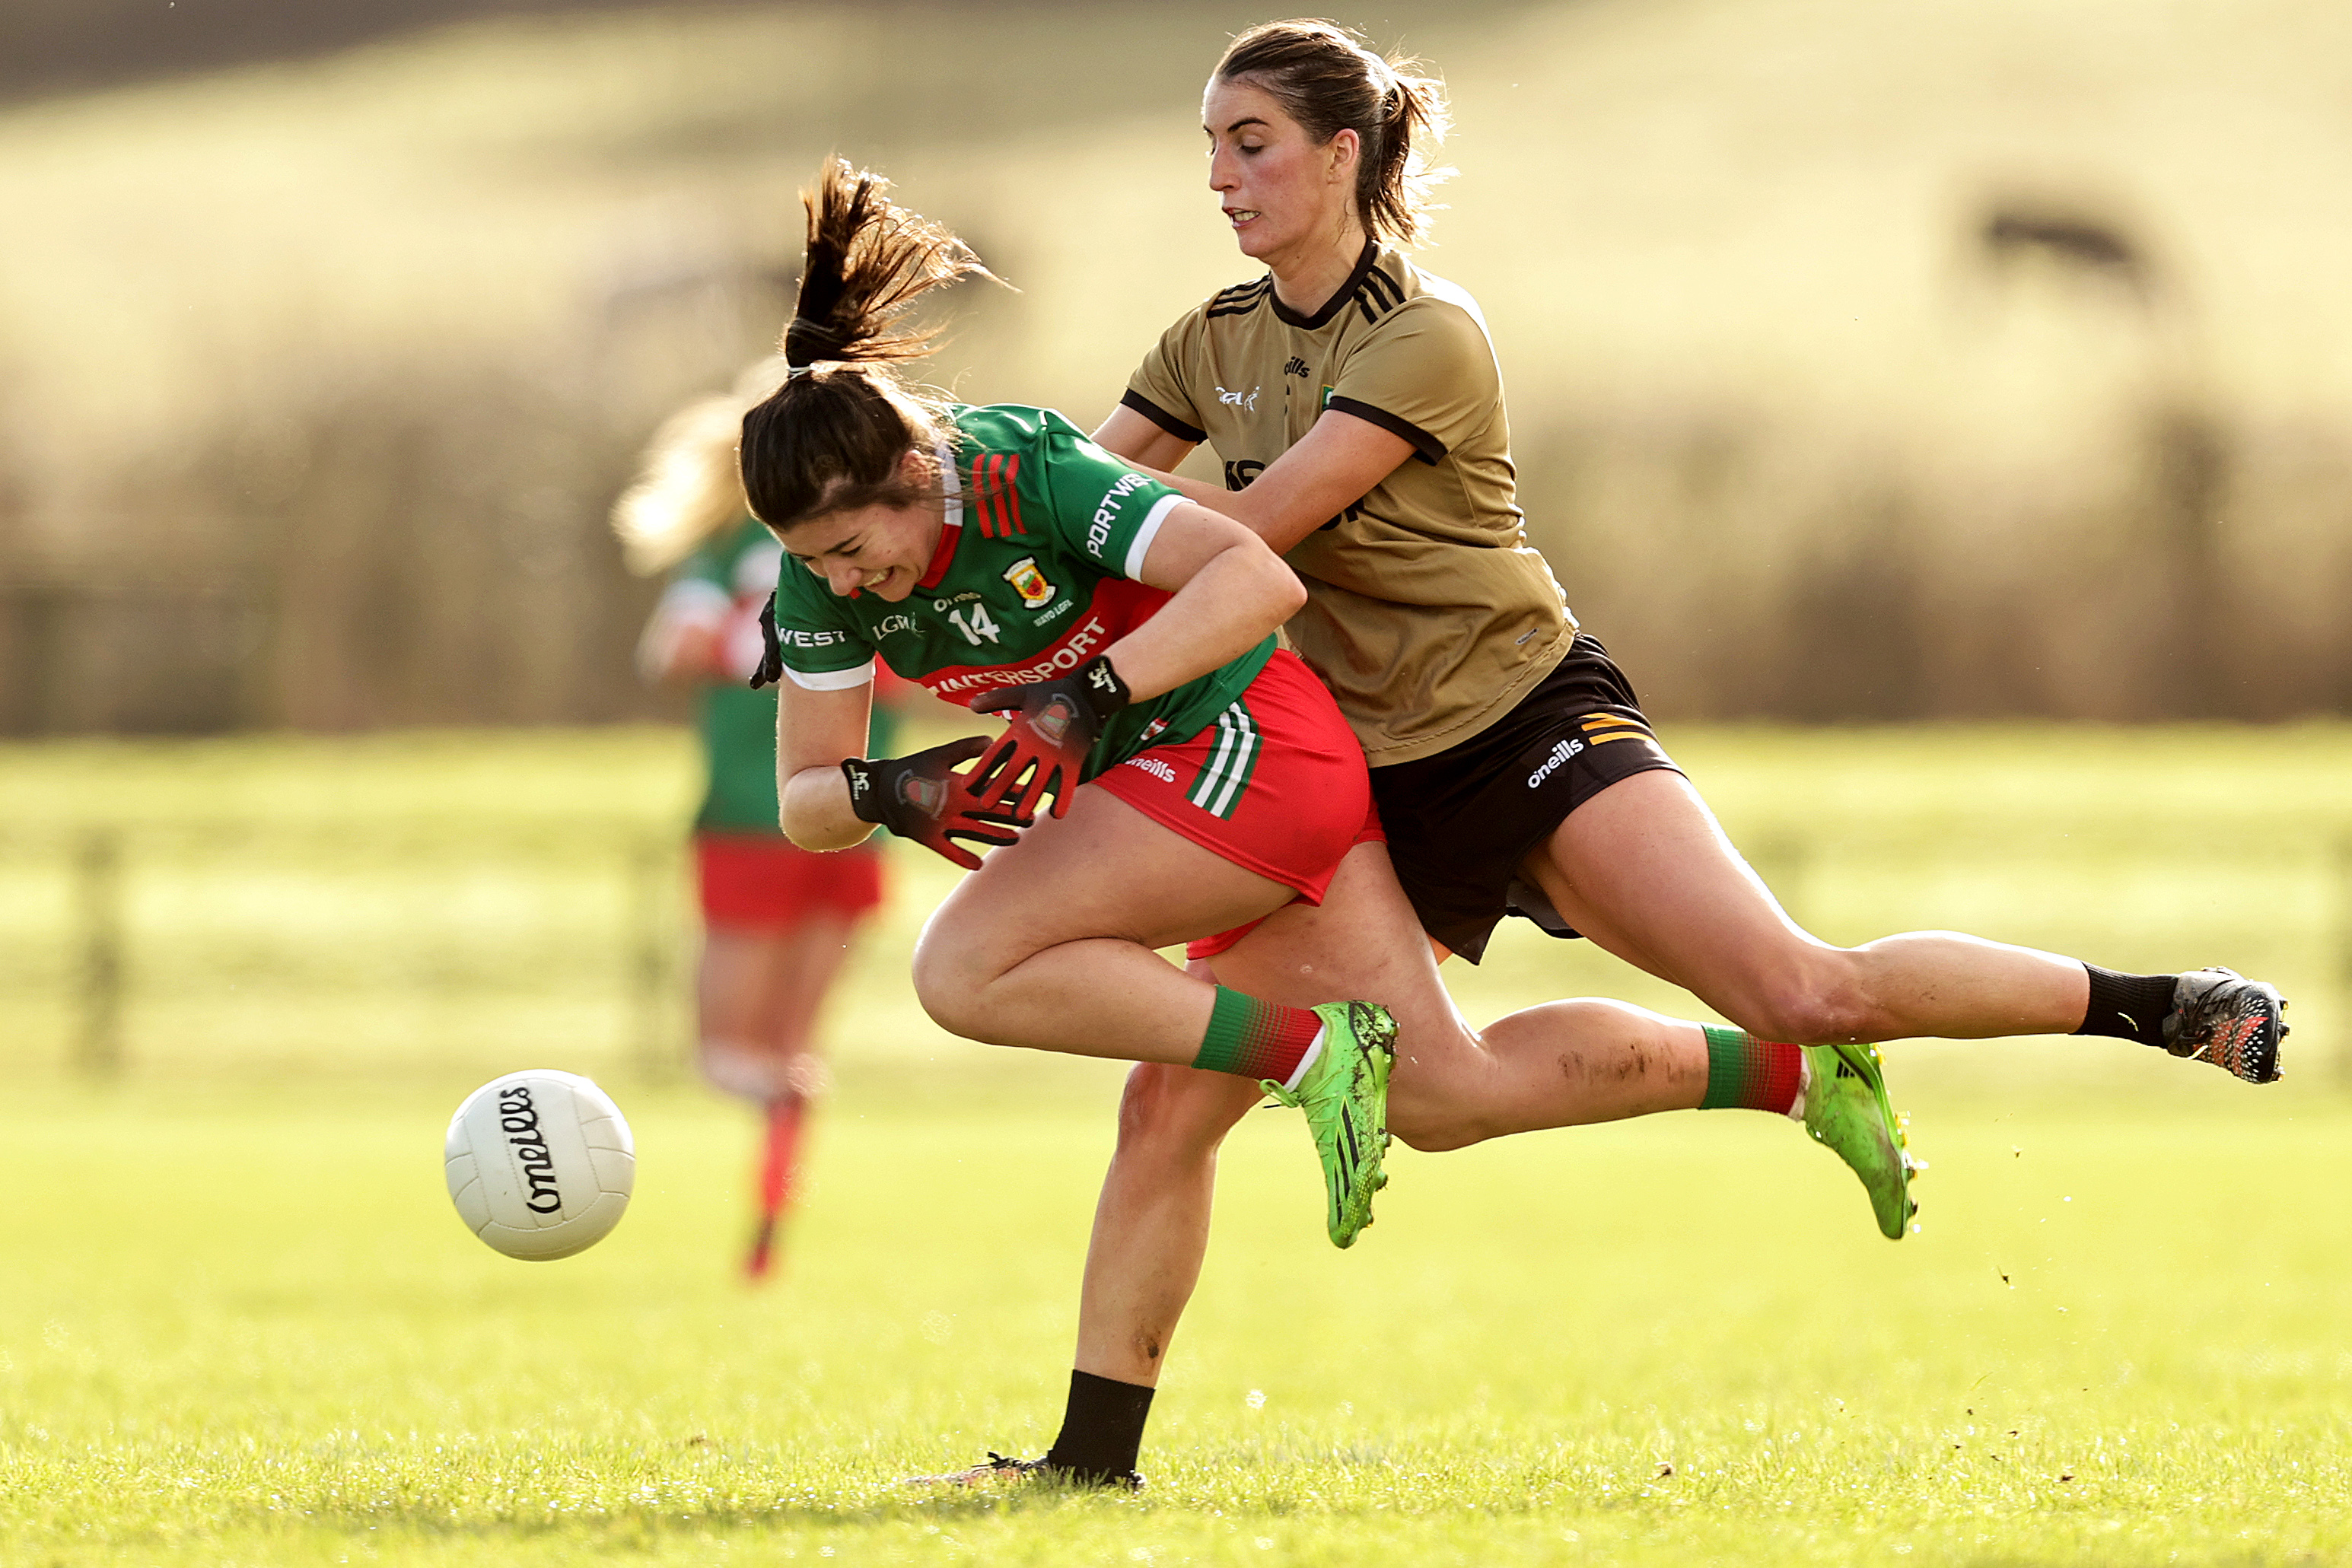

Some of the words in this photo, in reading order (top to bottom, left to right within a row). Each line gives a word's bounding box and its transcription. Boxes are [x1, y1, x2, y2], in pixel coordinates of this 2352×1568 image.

[774, 621, 845, 647] WEST
[948, 603, 1001, 646] 14
[940, 616, 1106, 692] INTERSPORT
